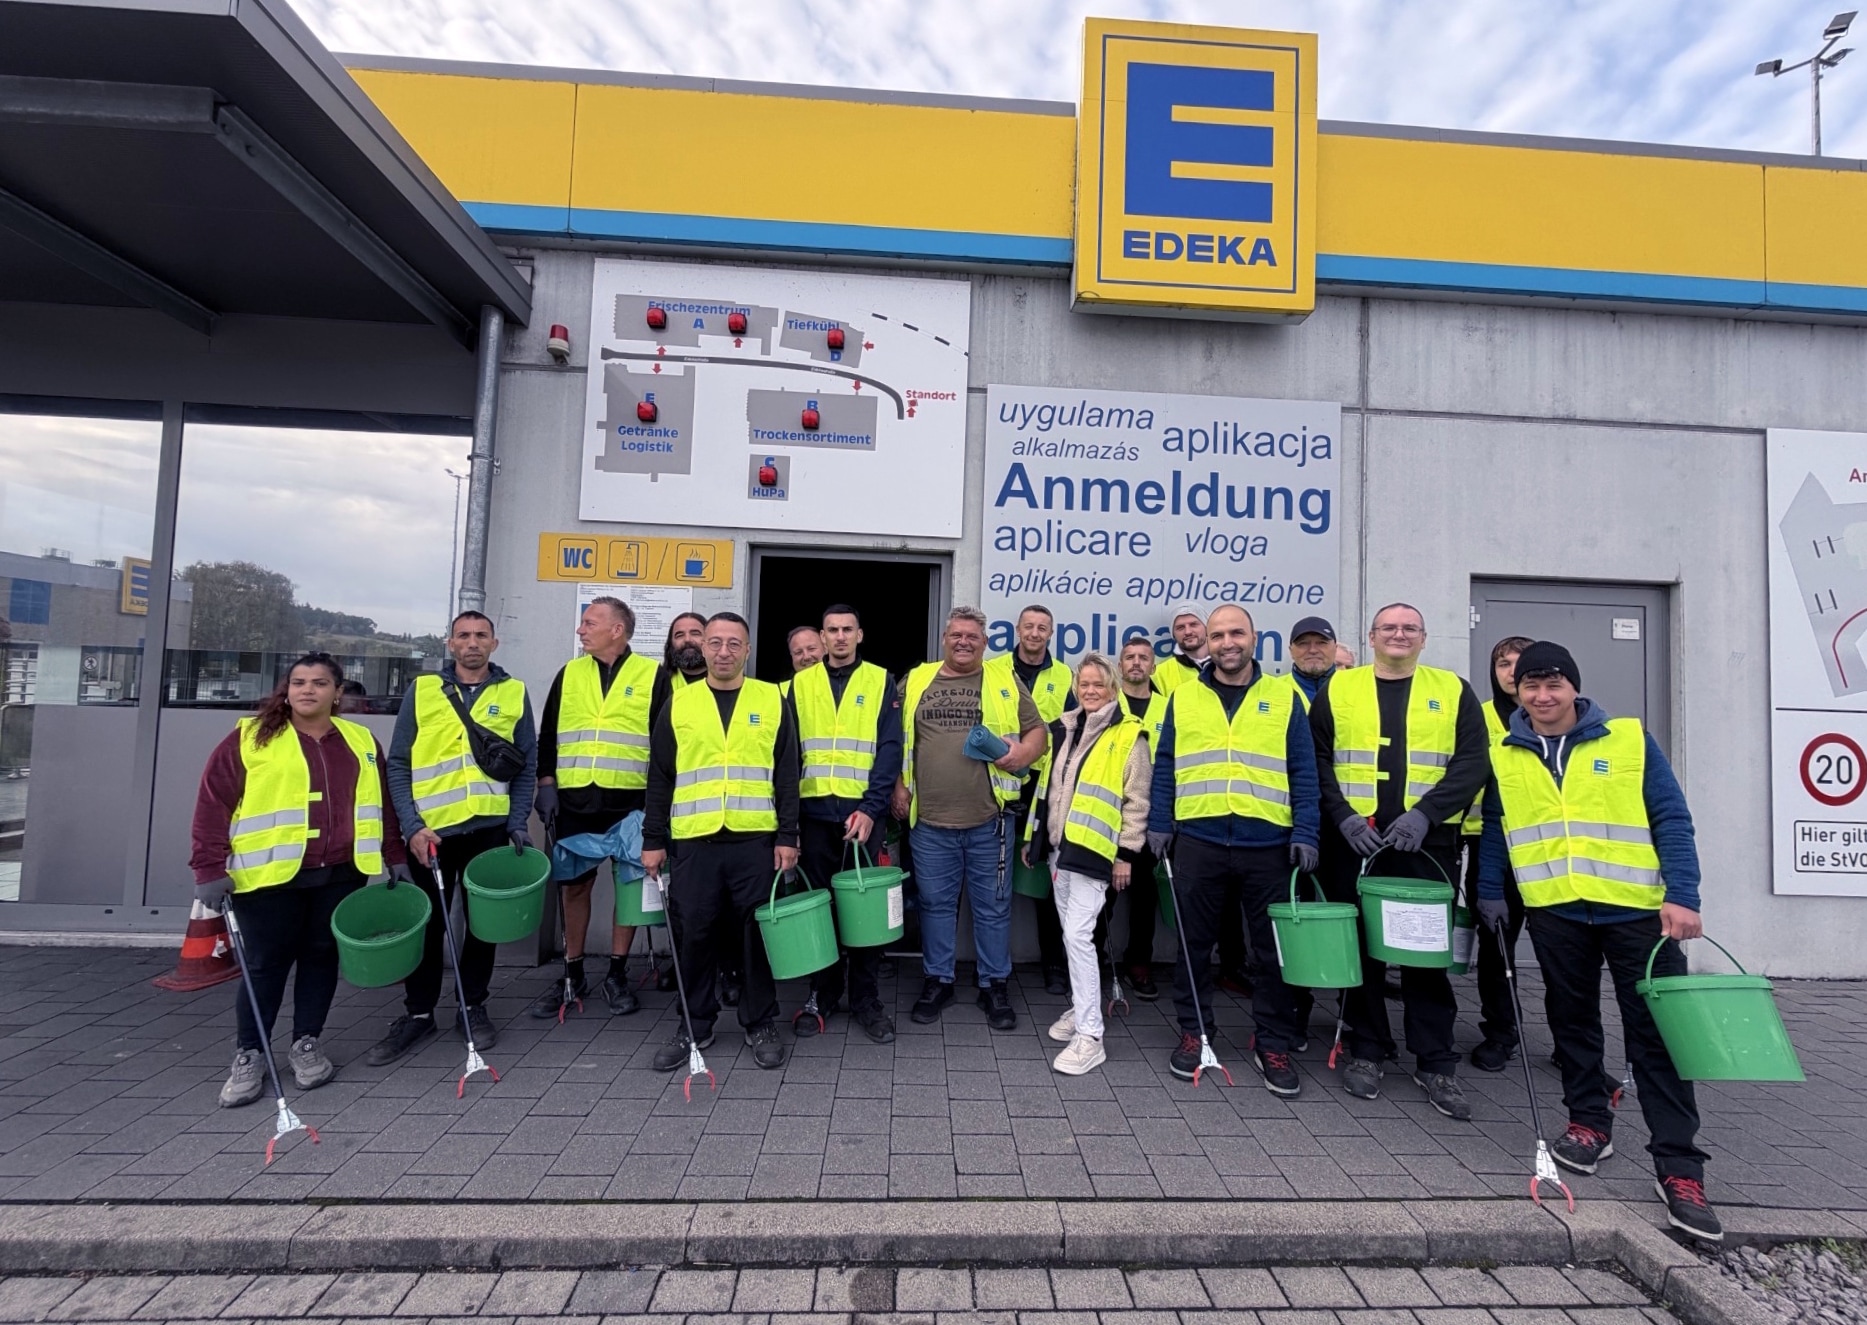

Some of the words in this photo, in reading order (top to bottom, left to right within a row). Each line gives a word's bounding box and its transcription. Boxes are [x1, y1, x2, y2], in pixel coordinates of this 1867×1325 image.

[1124, 61, 1274, 223] E
[1123, 229, 1278, 267] EDEKA
[648, 301, 751, 316] Frischezentrum
[693, 318, 705, 329] A
[787, 319, 839, 331] Tiefkühl
[830, 350, 841, 361] D
[645, 393, 655, 403] E
[906, 389, 957, 401] Standort
[807, 400, 818, 410] B
[999, 400, 1155, 431] uygulama
[617, 425, 679, 438] Getränke
[753, 429, 871, 445] Trockensortiment
[621, 440, 673, 453] Logistik
[1012, 437, 1140, 462] alkalmazás
[1162, 421, 1333, 467] aplikacja
[764, 457, 775, 467] C
[752, 487, 785, 498] HuPa
[994, 462, 1332, 534] Anmeldung
[994, 519, 1152, 561] aplicare
[1185, 527, 1269, 562] vloga
[563, 547, 593, 570] WC
[989, 569, 1113, 597] aplikácie
[1126, 573, 1325, 605] applicazione
[922, 709, 962, 720] INDIGO
[1816, 755, 1853, 785] 20
[1801, 827, 1837, 842] Hier
[1842, 828, 1867, 847] gilt
[1801, 851, 1826, 866] die
